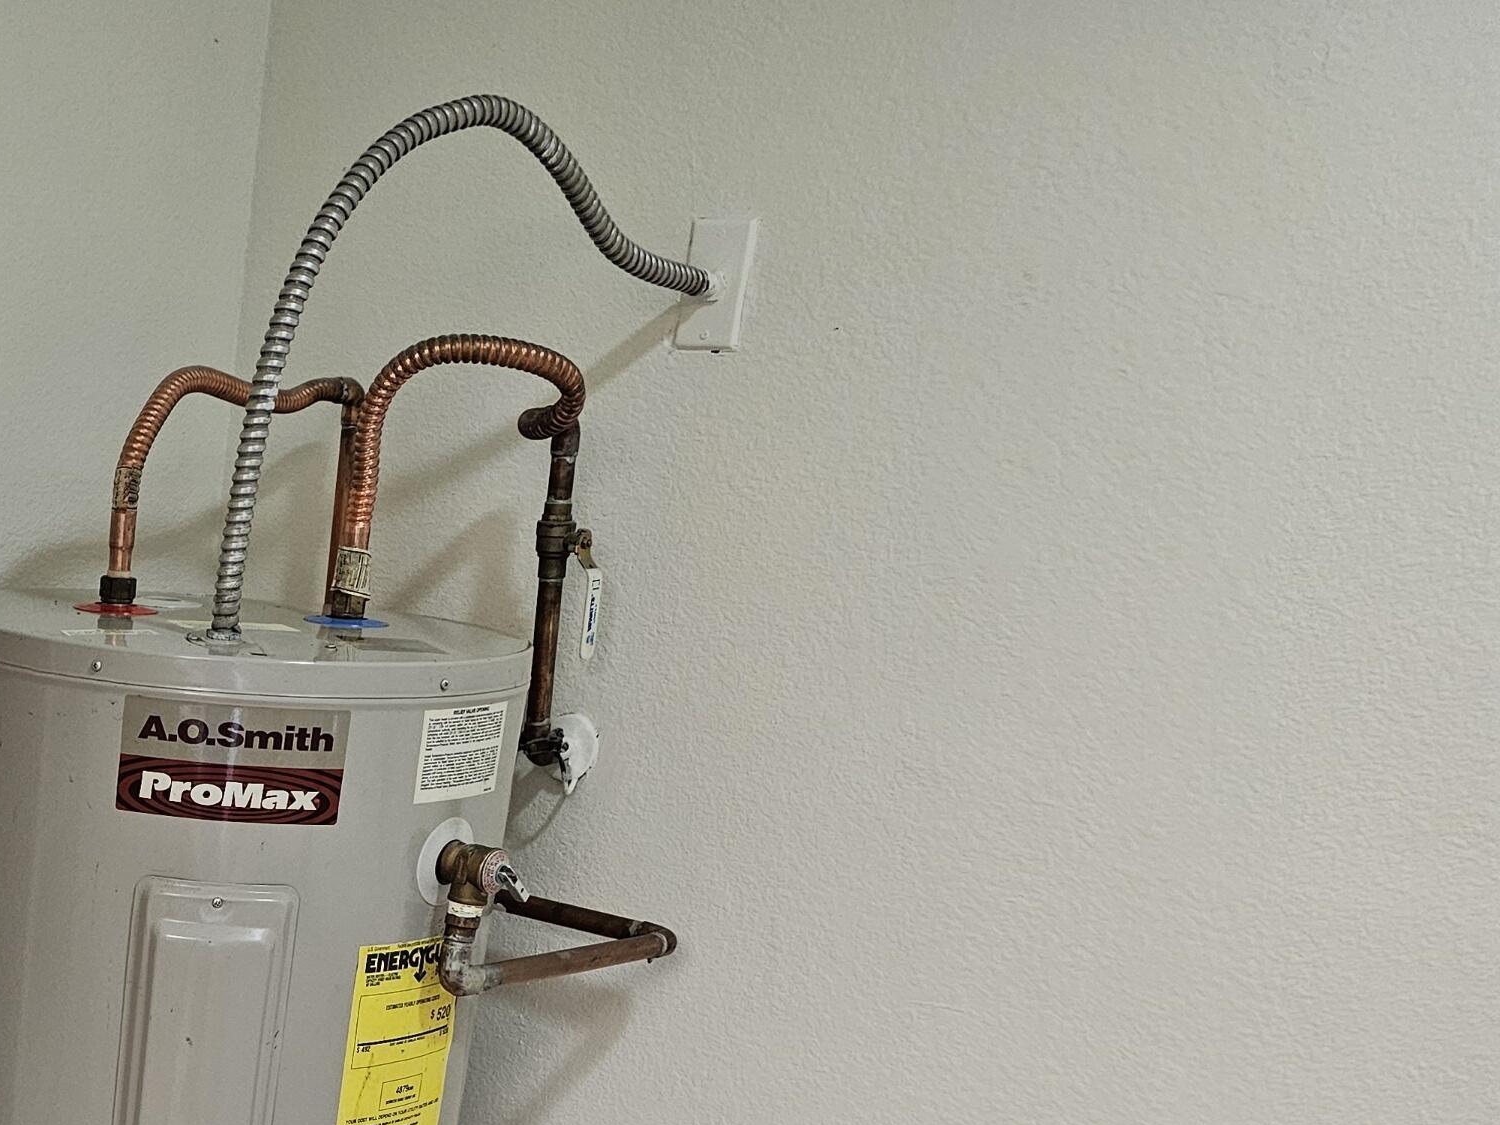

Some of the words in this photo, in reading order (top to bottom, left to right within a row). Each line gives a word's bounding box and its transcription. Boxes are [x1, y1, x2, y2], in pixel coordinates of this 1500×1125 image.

[138, 715, 334, 752] A.O.Smith
[139, 770, 319, 811] ProMax
[436, 1004, 451, 1021] 520
